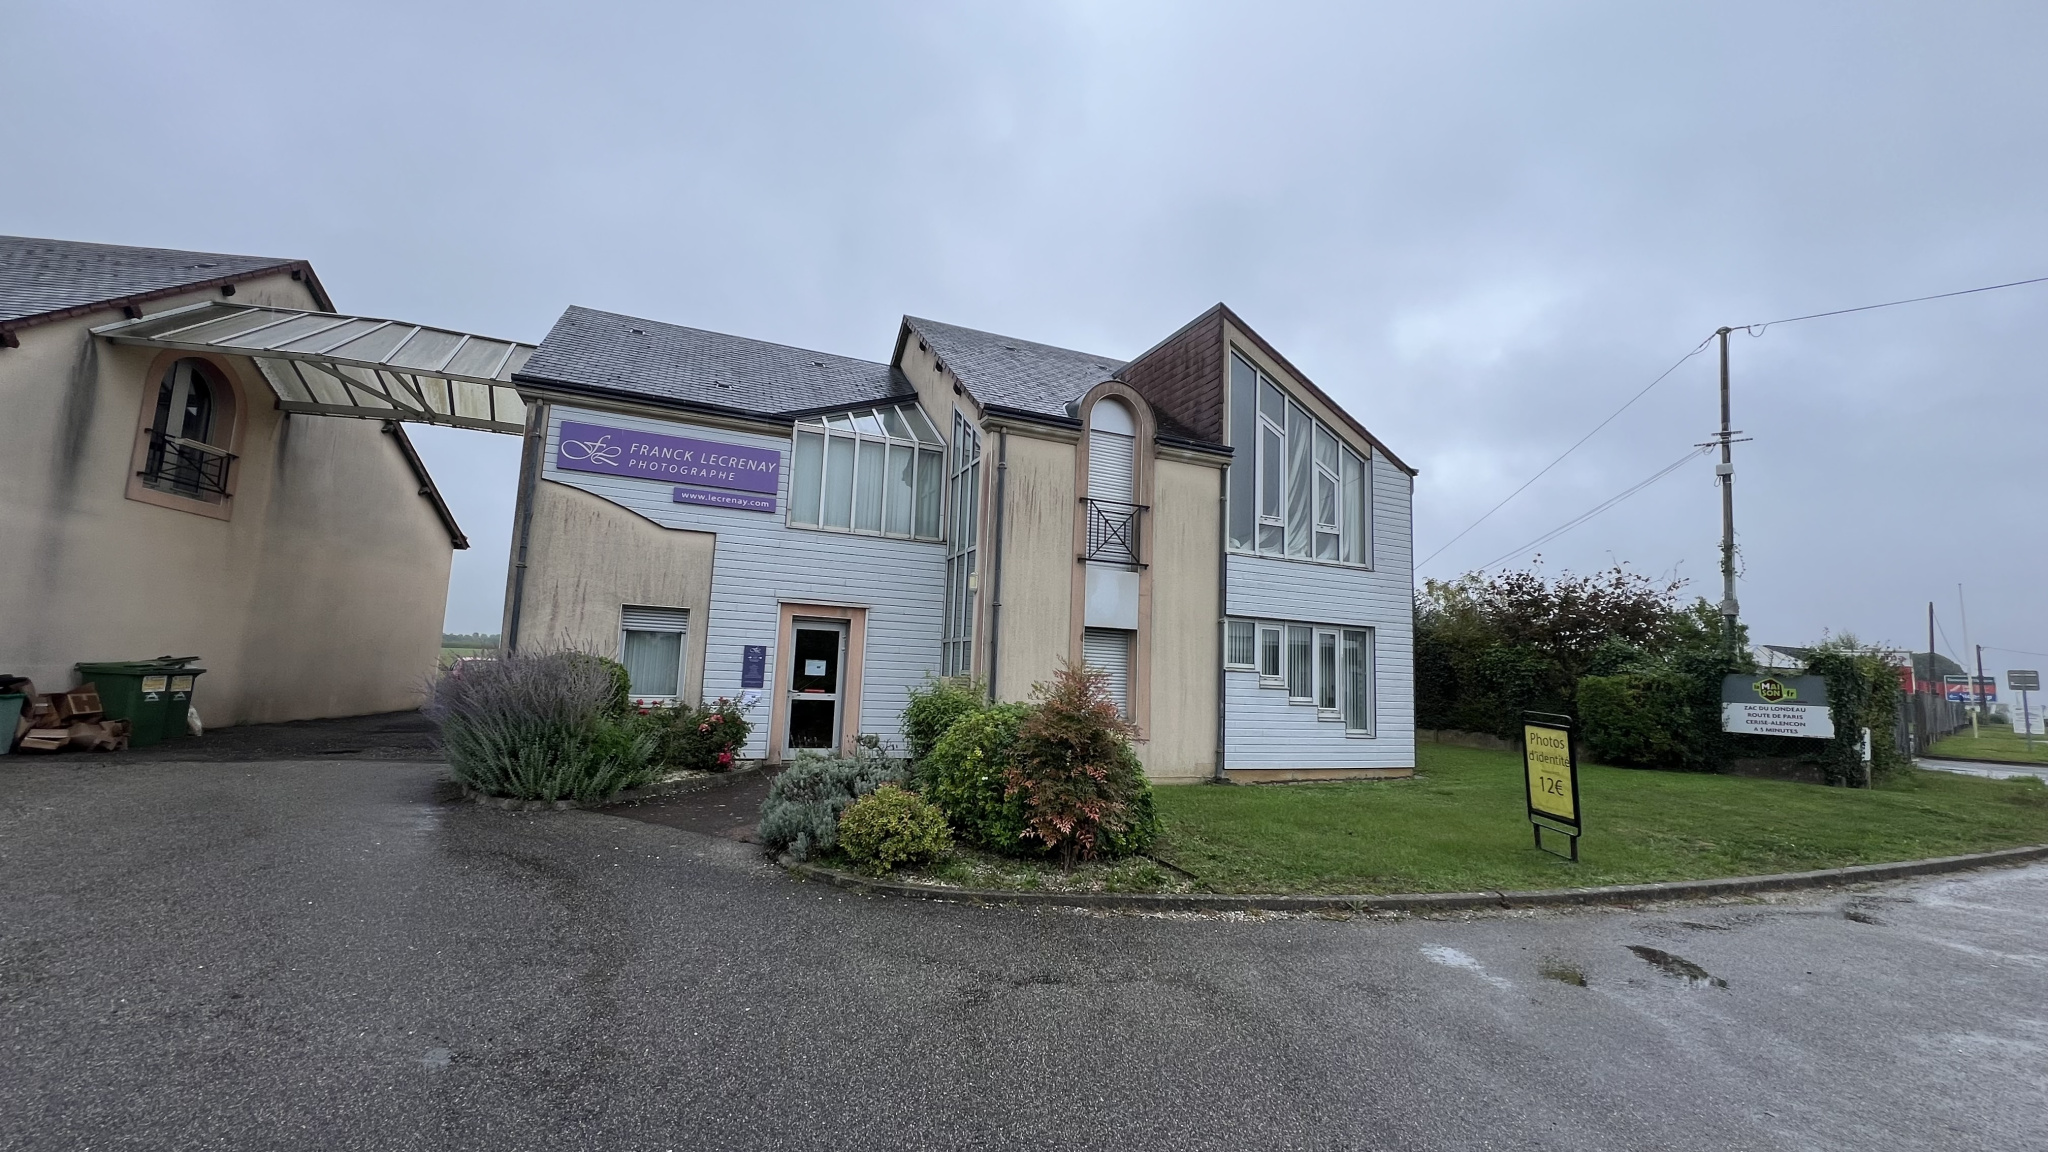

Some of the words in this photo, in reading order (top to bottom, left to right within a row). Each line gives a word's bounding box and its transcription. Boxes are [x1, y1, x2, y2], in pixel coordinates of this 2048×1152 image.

[630, 443, 694, 462] FRANCK
[701, 452, 777, 473] LECRENAY
[628, 459, 736, 481] PHOTOGRAPHE
[681, 491, 770, 508] www.lecrenay.com
[1530, 732, 1565, 750] Photos
[1529, 750, 1570, 768] d'identité
[1539, 776, 1564, 796] 12€
